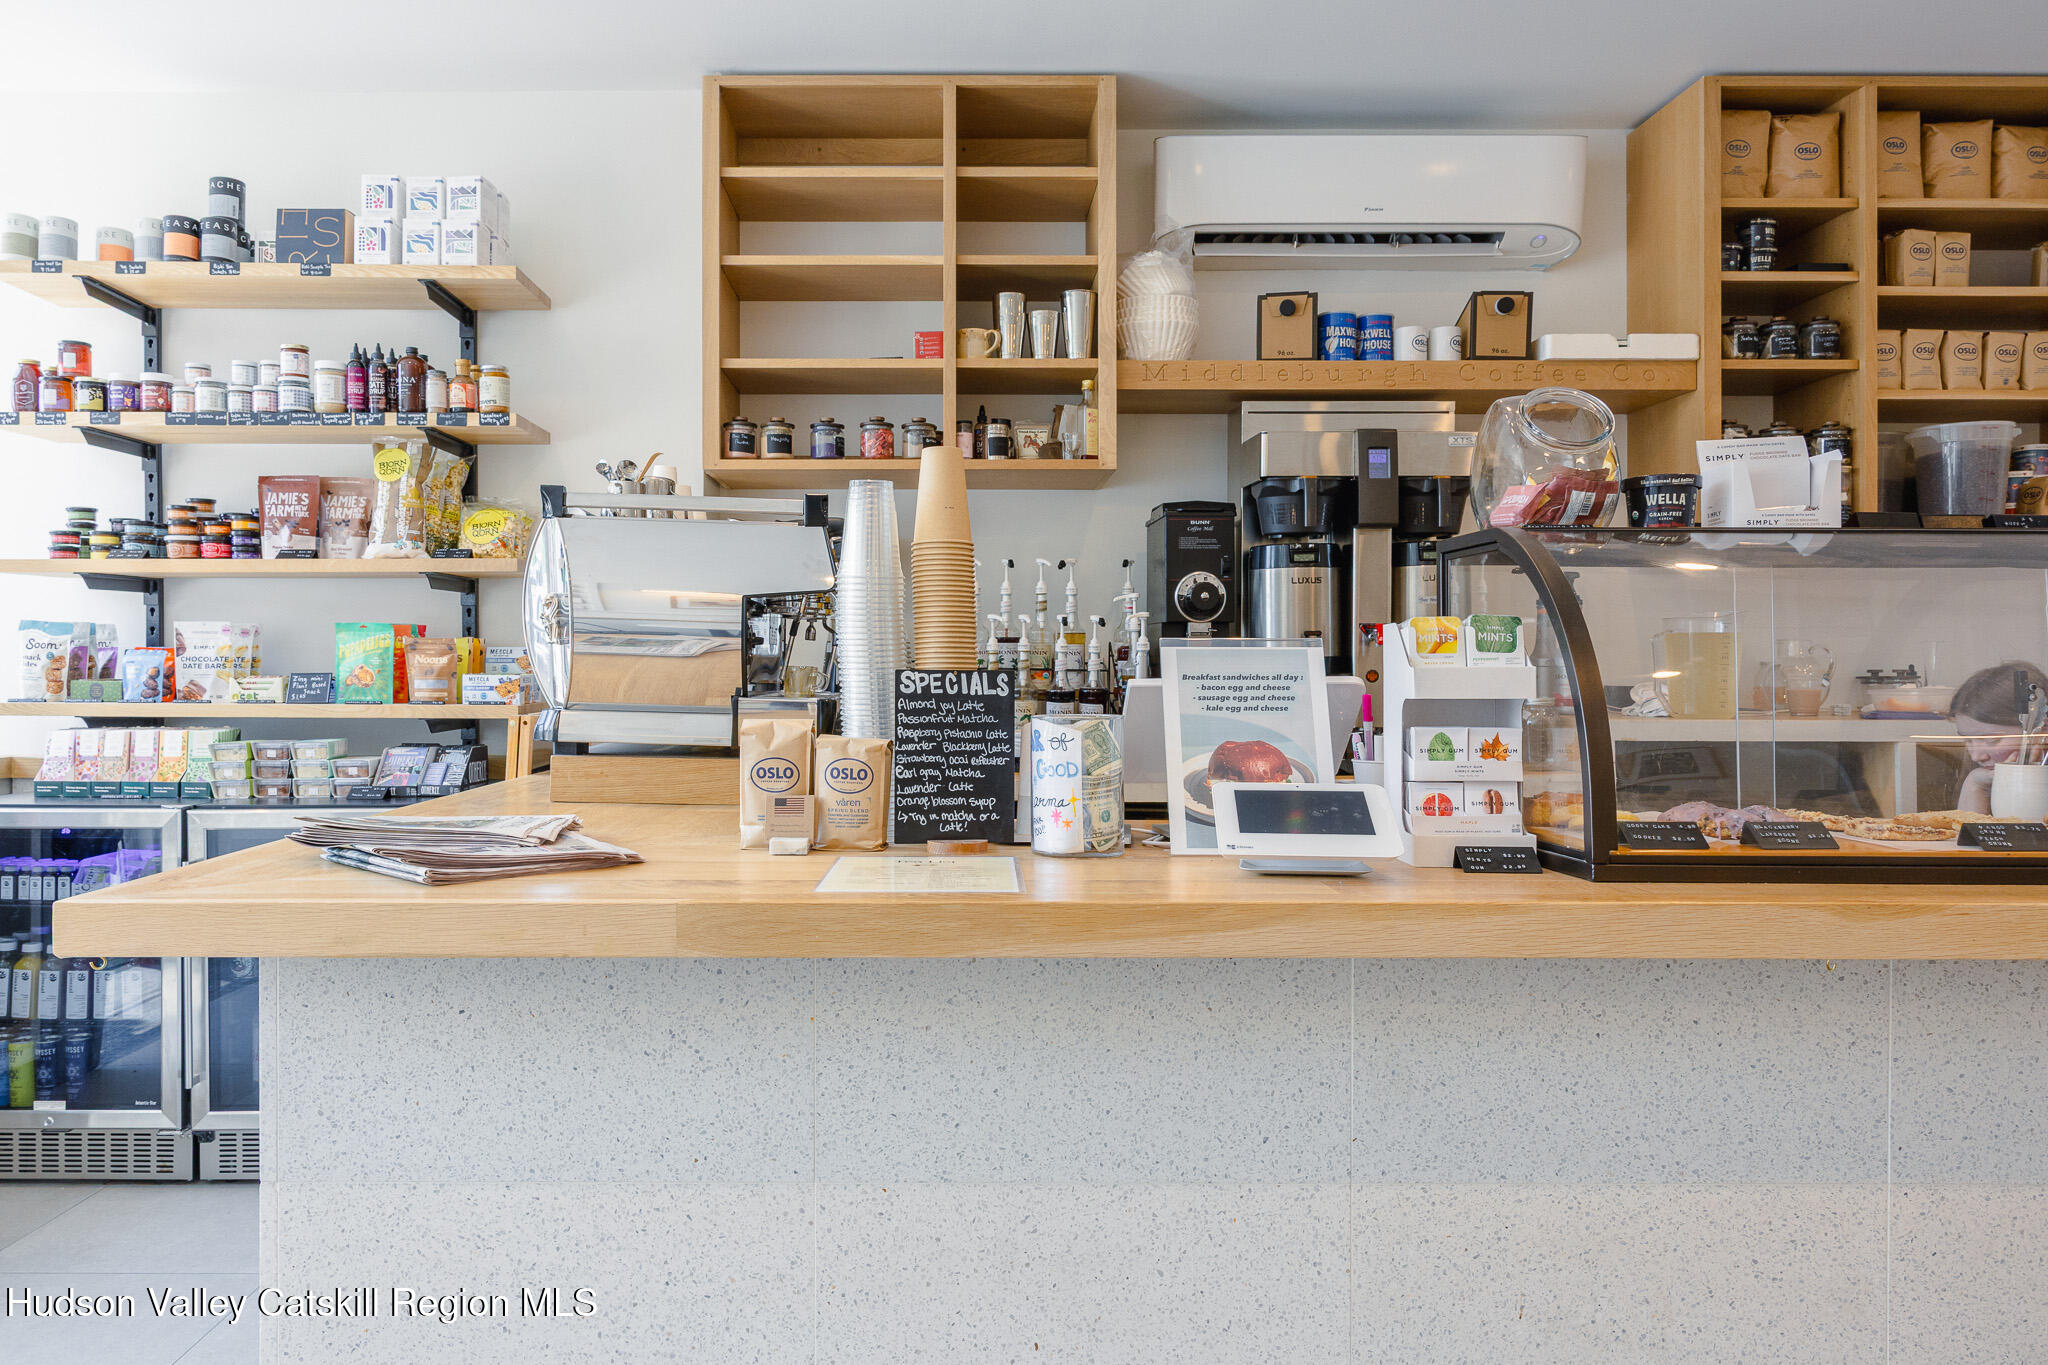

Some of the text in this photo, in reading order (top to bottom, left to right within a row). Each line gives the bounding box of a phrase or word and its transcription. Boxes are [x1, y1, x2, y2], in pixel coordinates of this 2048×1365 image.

[1798, 146, 1819, 154] OSLO
[1886, 141, 1905, 150] OSLO
[1360, 328, 1391, 338] AXWELL
[1364, 340, 1391, 350] HOUSE
[1142, 363, 1672, 388] Middleburgh Coffee Co.
[1451, 436, 1475, 446] XTS
[1705, 453, 1744, 462] SIMPLY
[378, 458, 407, 470] BJORN
[378, 466, 405, 476] QORN
[264, 492, 310, 505] JAMIE'S
[324, 496, 368, 508] JAMIE'S
[1645, 493, 1686, 506] WELLA
[264, 505, 296, 518] FARM
[324, 507, 353, 520] FARM
[472, 520, 501, 530] BJORN
[472, 528, 500, 537] QORN
[1291, 576, 1322, 584] LUXUS
[1418, 634, 1454, 644] MINTS
[1478, 633, 1514, 643] MINTS
[900, 671, 1010, 697] SPECIALS
[1283, 674, 1299, 682] day
[898, 698, 985, 715] Almond joy Latte
[897, 712, 998, 724] Passionfruit Matcha
[897, 726, 942, 741] Raspberry
[985, 729, 1009, 739] Latte
[1048, 732, 1074, 752] of
[895, 741, 1012, 756] Lavender Blackberry Latte
[896, 754, 947, 768] Strawberry
[756, 767, 794, 779] OSLO
[830, 767, 868, 780] OSLO
[896, 766, 917, 779] Earl
[945, 768, 986, 778] Matcha
[1036, 758, 1079, 780] GOOD
[897, 782, 974, 794] Lavender Latte
[897, 797, 996, 810] Orange blossom syrup
[1033, 796, 1070, 808] arma
[941, 812, 976, 821] matcha
[980, 813, 989, 821] or
[940, 822, 968, 832] Latte!
